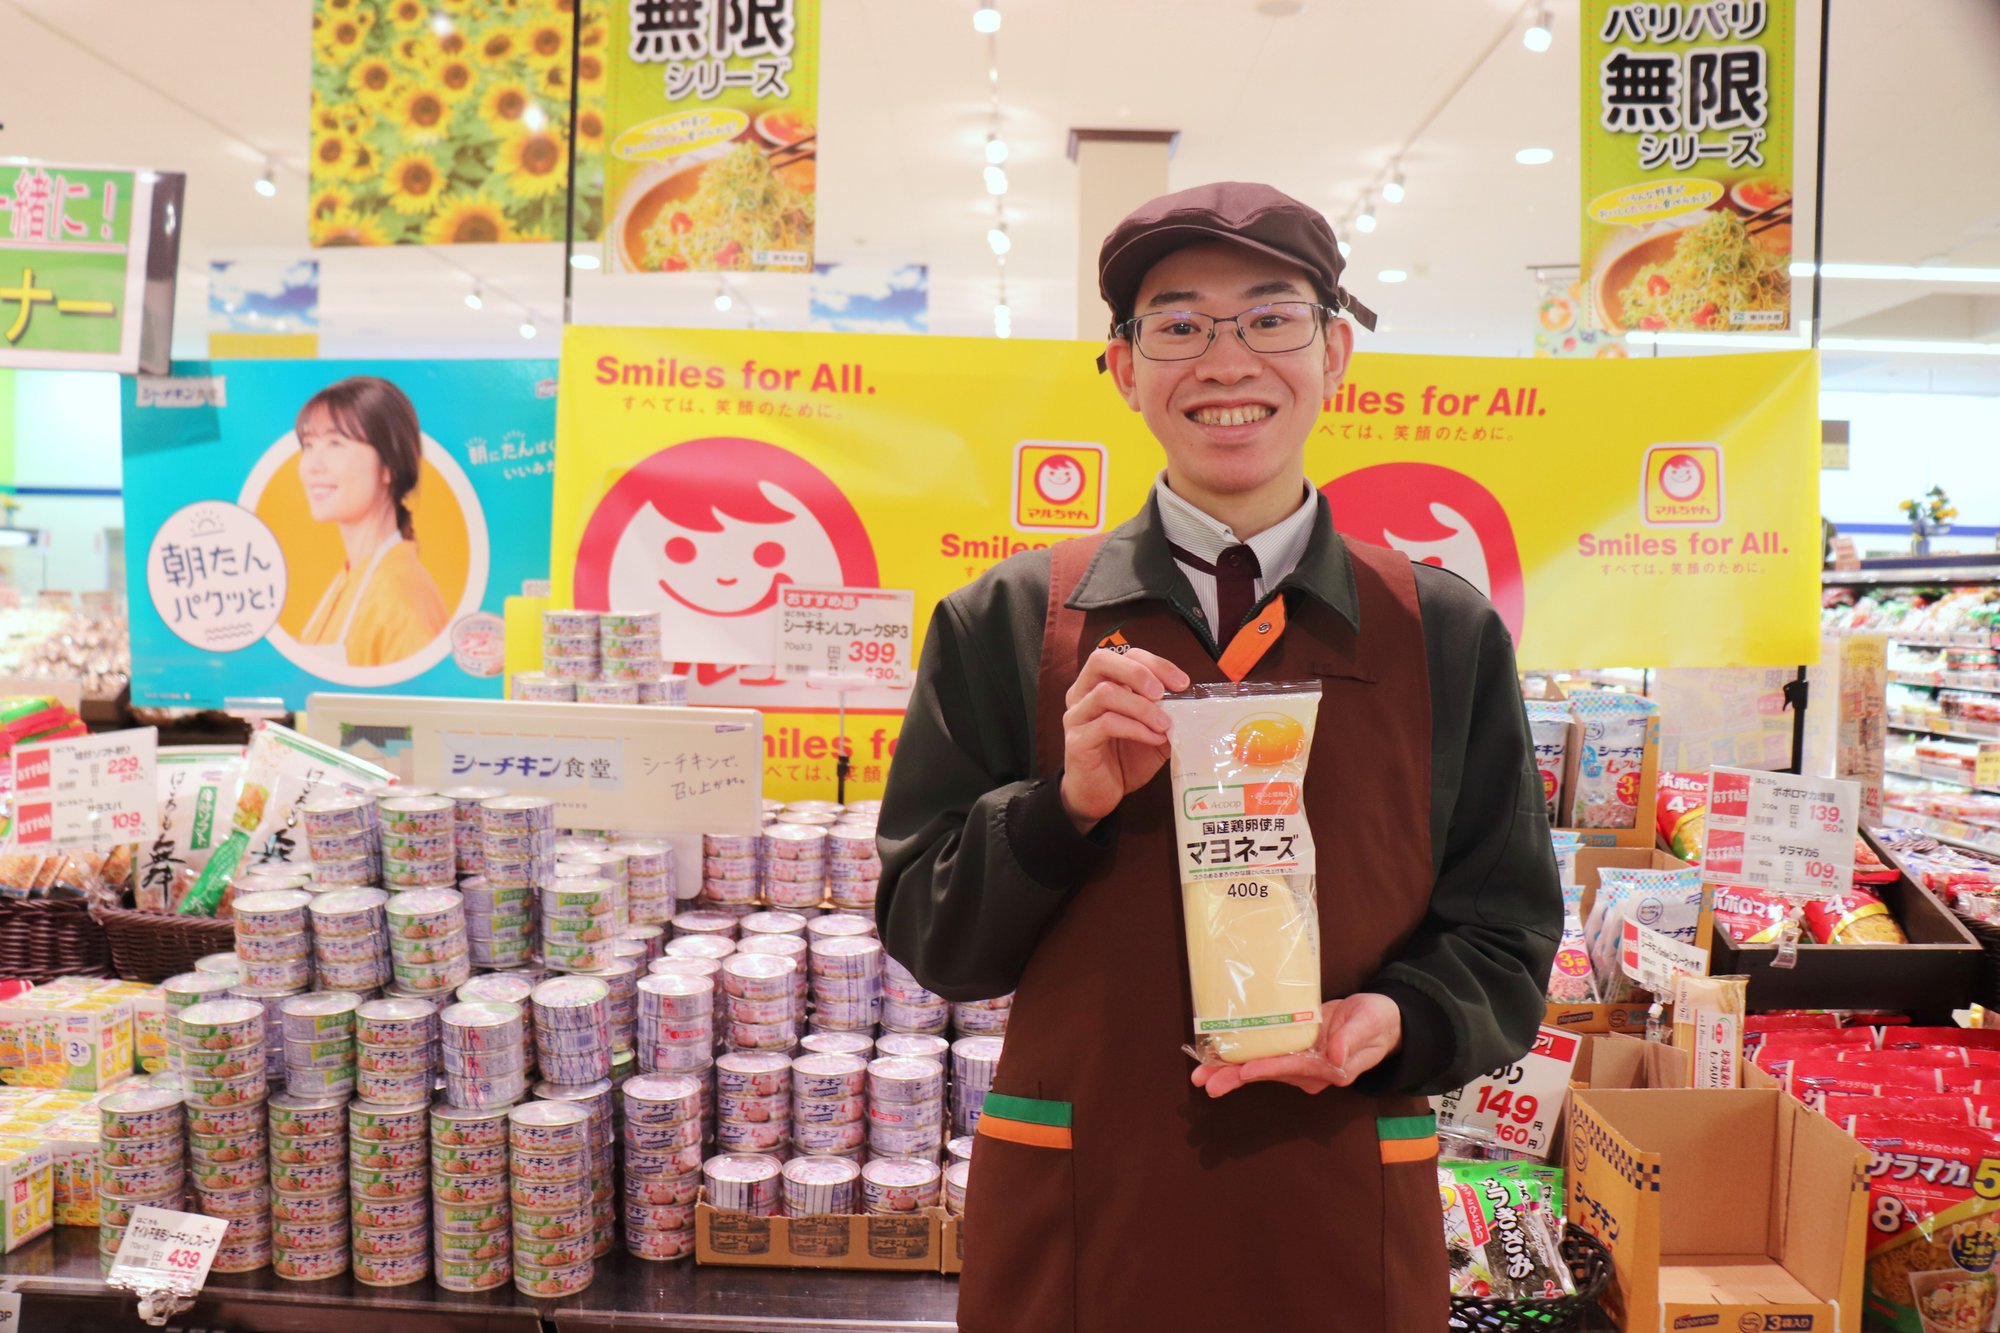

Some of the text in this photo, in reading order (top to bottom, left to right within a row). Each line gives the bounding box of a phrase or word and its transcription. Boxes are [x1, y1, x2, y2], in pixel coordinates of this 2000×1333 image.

[636, 0, 786, 53] 無限
[1605, 2, 1763, 37] パリパリ
[669, 61, 788, 95] シリーズ
[1606, 51, 1761, 126] 無限
[1642, 132, 1763, 166] シリーズ
[595, 355, 725, 389] Smiles
[742, 360, 800, 391] for
[811, 363, 876, 395] All.
[624, 396, 844, 420] すべては、笑顔のために。
[1422, 386, 1480, 416] for
[1486, 388, 1546, 416] All.
[1028, 508, 1089, 520] マルちゃん
[1655, 506, 1711, 515] マルちゃん
[1578, 532, 1789, 557] Smiles for All.
[161, 542, 271, 588] 朝たん
[1602, 562, 1766, 576] すべては、笑顔のために。
[784, 620, 908, 639] シーチキンLフレークSP3
[848, 641, 895, 663] 399
[865, 667, 894, 679] 430
[107, 756, 138, 774] 229
[1713, 789, 1748, 803] おすすめ品
[112, 812, 141, 829] 109
[1809, 805, 1839, 822] 139
[1203, 818, 1285, 835] 国産鶏卵使用
[1187, 834, 1298, 865] マヨネーズ
[1804, 861, 1835, 878] 109
[1227, 882, 1269, 899] 400g
[1476, 1085, 1538, 1124] 149
[1496, 1123, 1529, 1144] 160
[1905, 1139, 1971, 1155] サラダのための
[1574, 1180, 1620, 1241] シーチキン
[168, 1249, 200, 1269] 439
